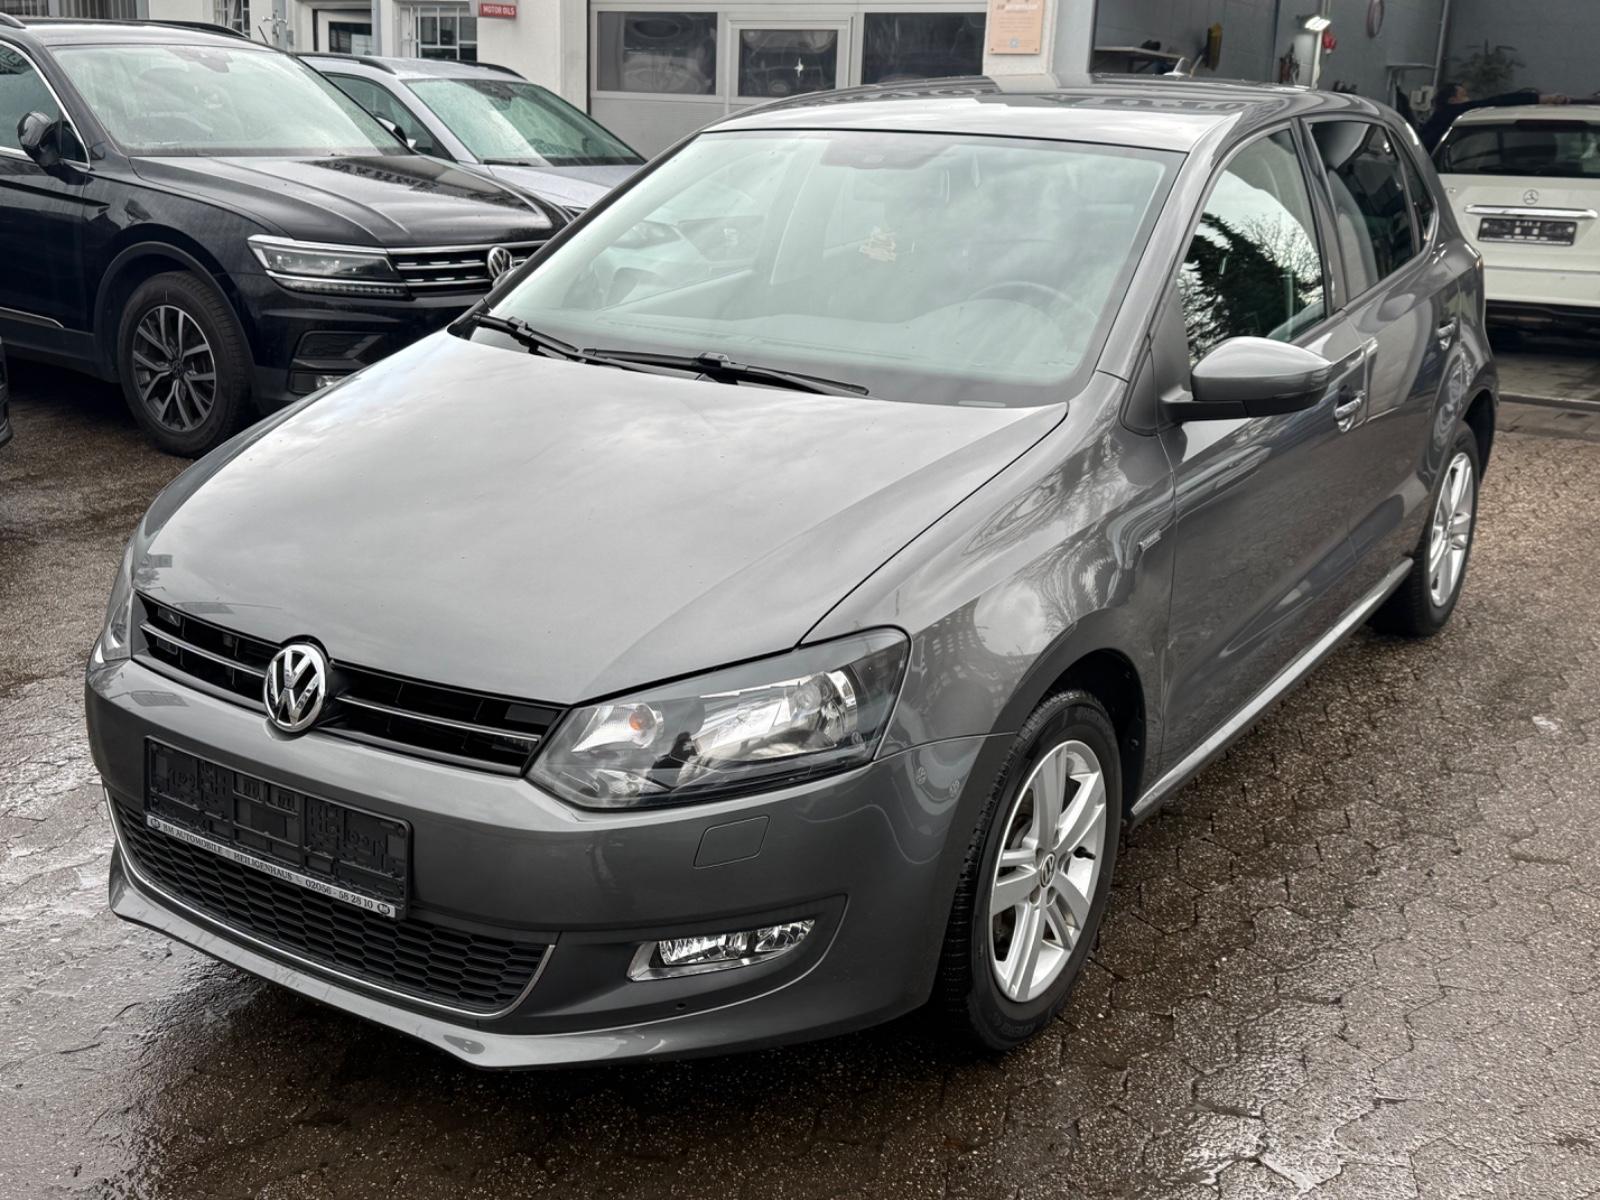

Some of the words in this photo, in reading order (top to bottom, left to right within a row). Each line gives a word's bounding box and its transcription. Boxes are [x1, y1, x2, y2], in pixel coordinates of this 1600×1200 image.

[482, 5, 502, 15] MOTOR
[502, 6, 515, 16] OILS
[176, 828, 221, 854] AUTOMOBILE
[363, 898, 373, 909] 10
